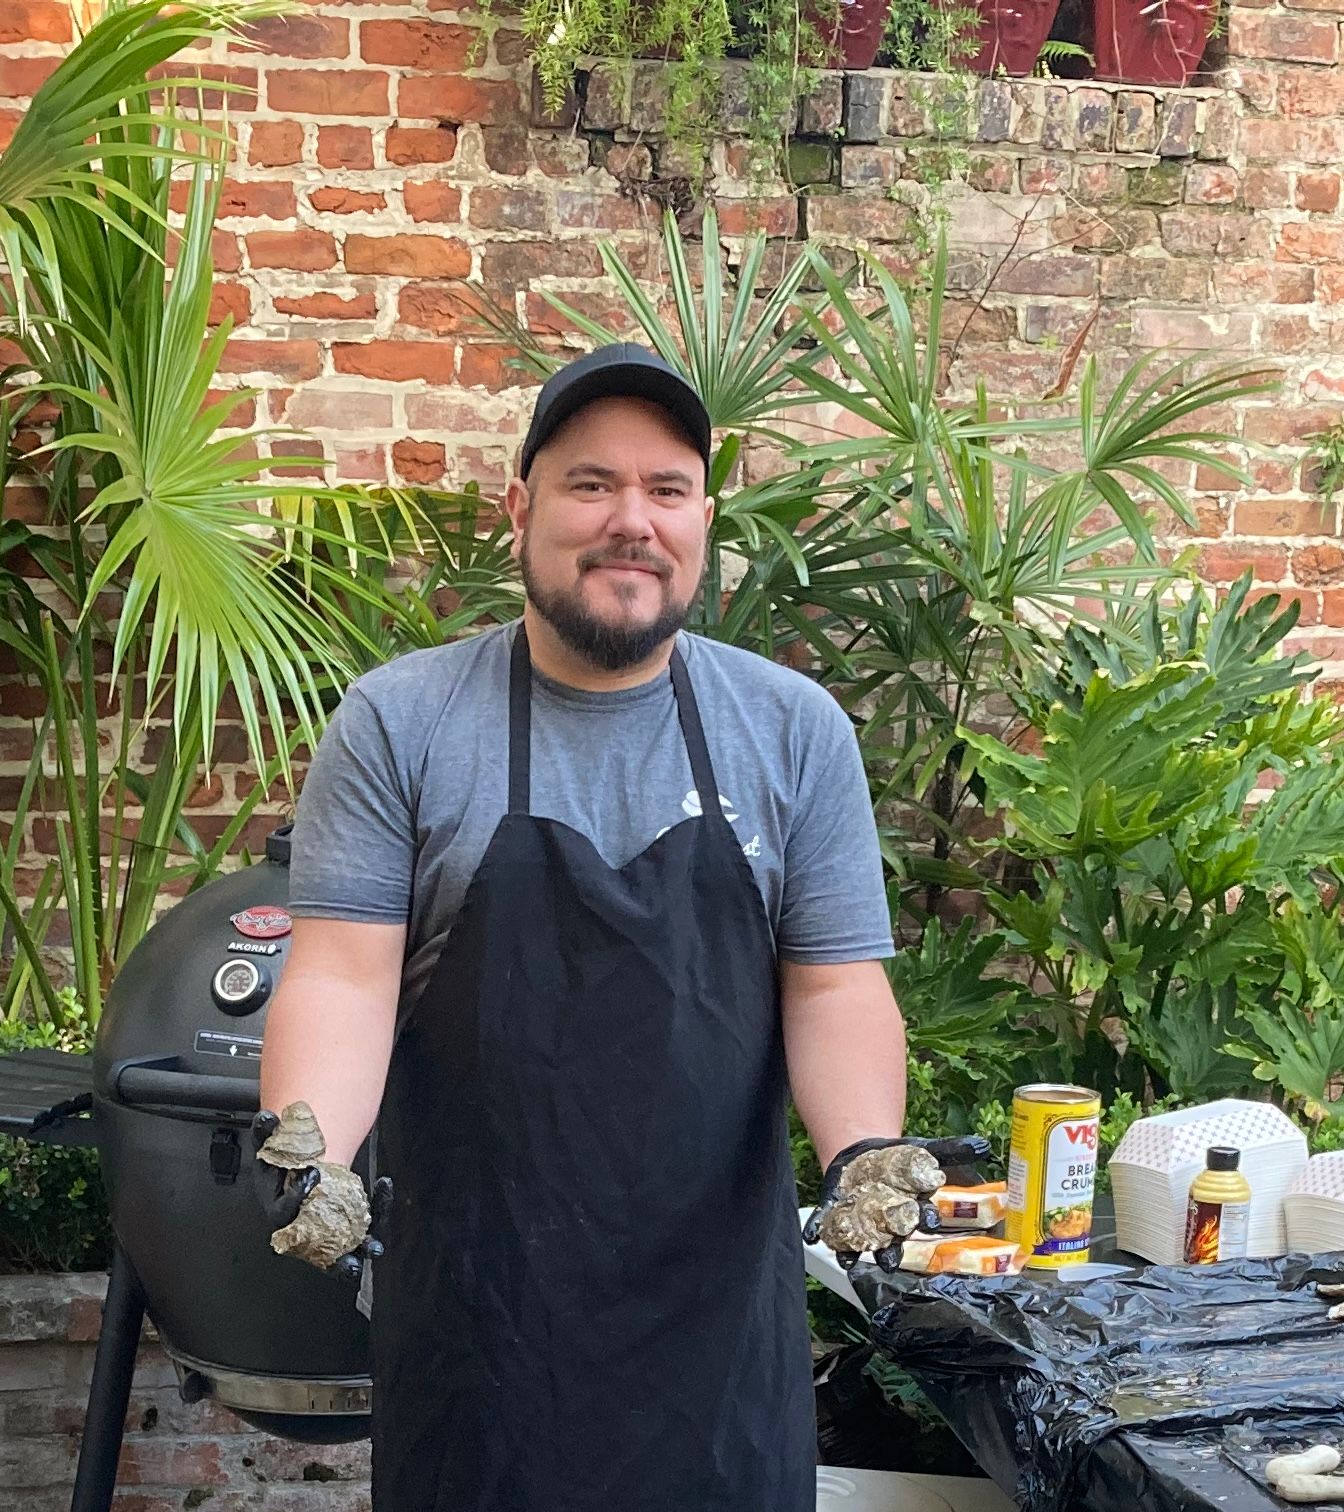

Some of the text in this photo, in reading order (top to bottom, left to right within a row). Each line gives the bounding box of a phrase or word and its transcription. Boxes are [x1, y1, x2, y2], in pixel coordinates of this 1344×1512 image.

[227, 942, 267, 953] AKORN
[1063, 1125, 1098, 1151] VIG
[1067, 1163, 1095, 1177] BREA
[1060, 1177, 1093, 1191] CRUM
